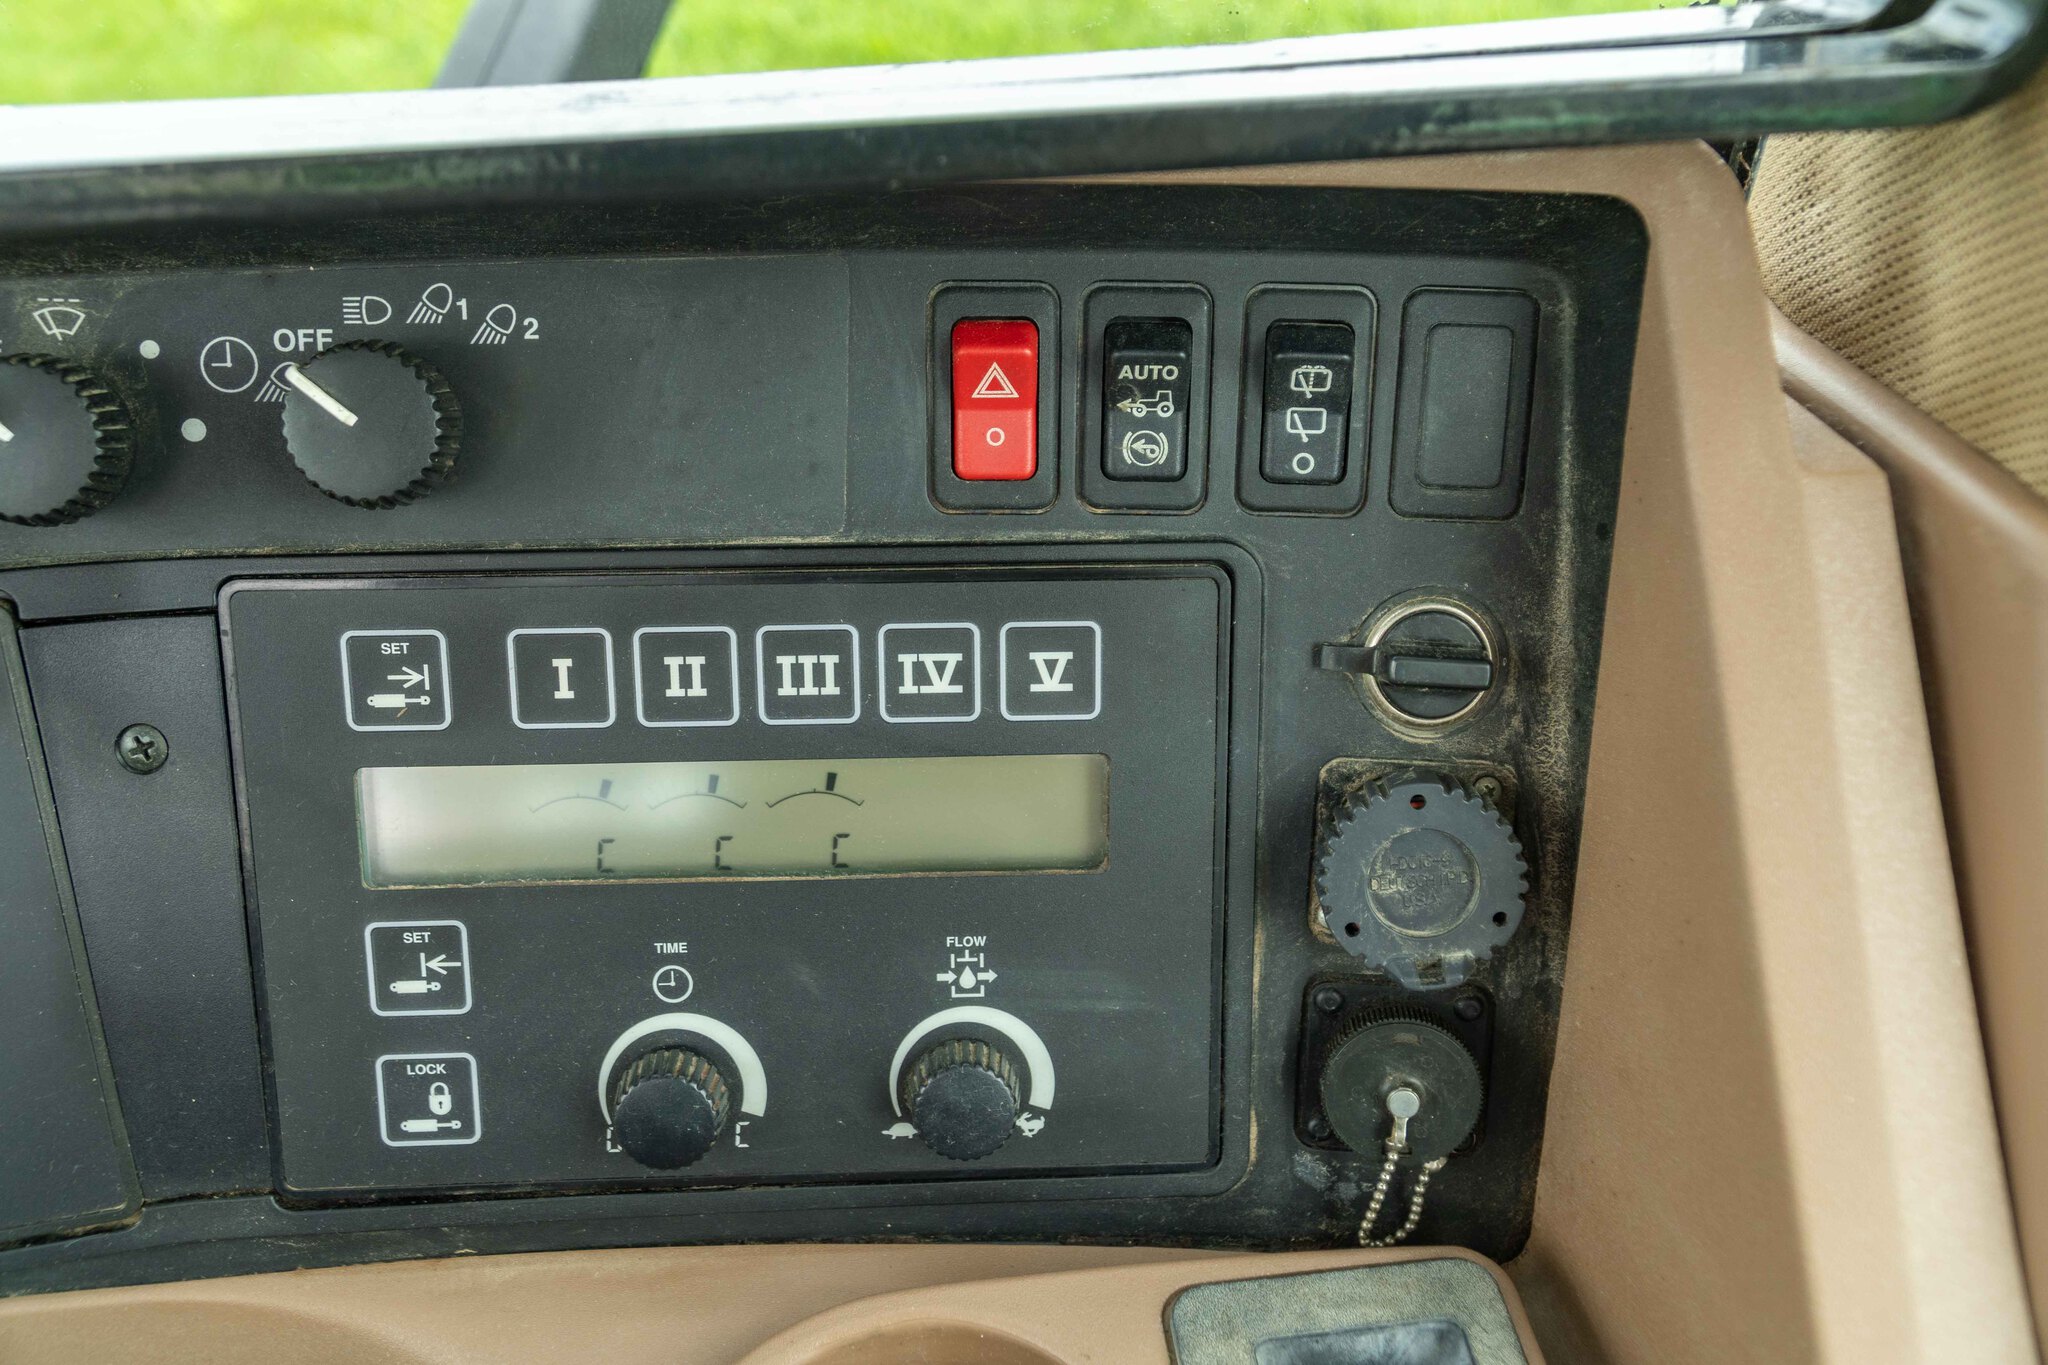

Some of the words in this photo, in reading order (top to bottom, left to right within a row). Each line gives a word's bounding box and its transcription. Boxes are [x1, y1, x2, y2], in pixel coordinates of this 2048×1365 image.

[455, 298, 469, 321] 1
[272, 328, 334, 352] OFF
[522, 317, 540, 340] 2
[1117, 364, 1179, 381] AUTO
[380, 641, 410, 655] SET
[551, 657, 576, 699] I
[662, 655, 709, 697] II
[775, 654, 841, 696] III
[896, 652, 965, 695] IV
[1028, 651, 1075, 693] V
[402, 930, 432, 944] SET
[653, 941, 689, 955] TIME
[945, 935, 988, 948] FLOW
[405, 1062, 448, 1076] LOCK
